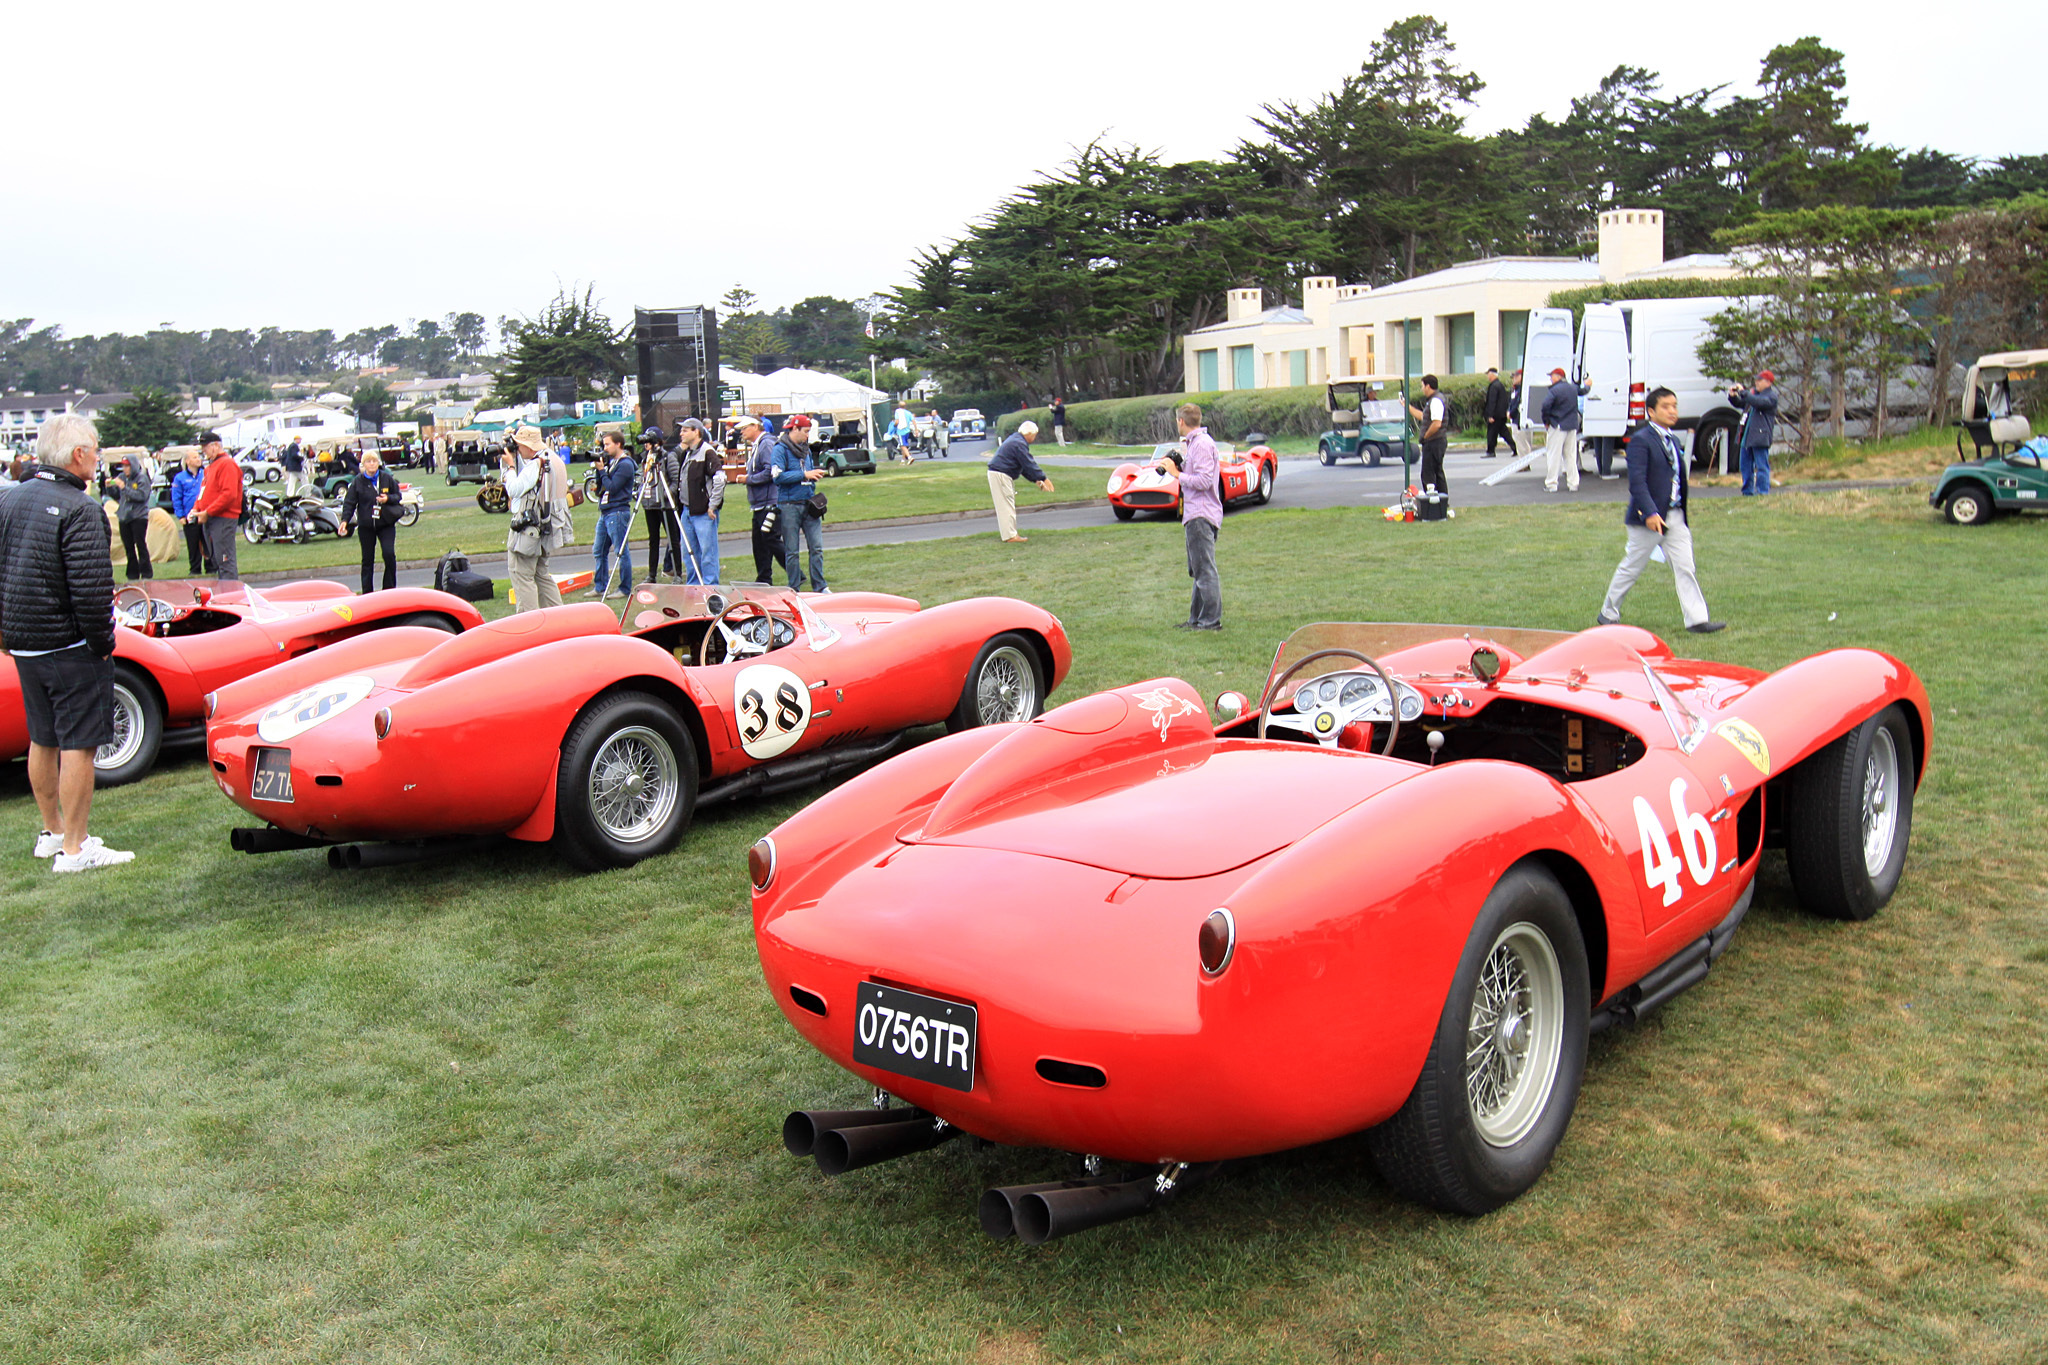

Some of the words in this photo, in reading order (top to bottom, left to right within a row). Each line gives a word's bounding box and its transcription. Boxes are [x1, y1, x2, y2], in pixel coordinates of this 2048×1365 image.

[741, 683, 804, 743] 38
[256, 770, 275, 794] 57
[1633, 777, 1717, 907] 46
[859, 1003, 969, 1071] 0756TR
